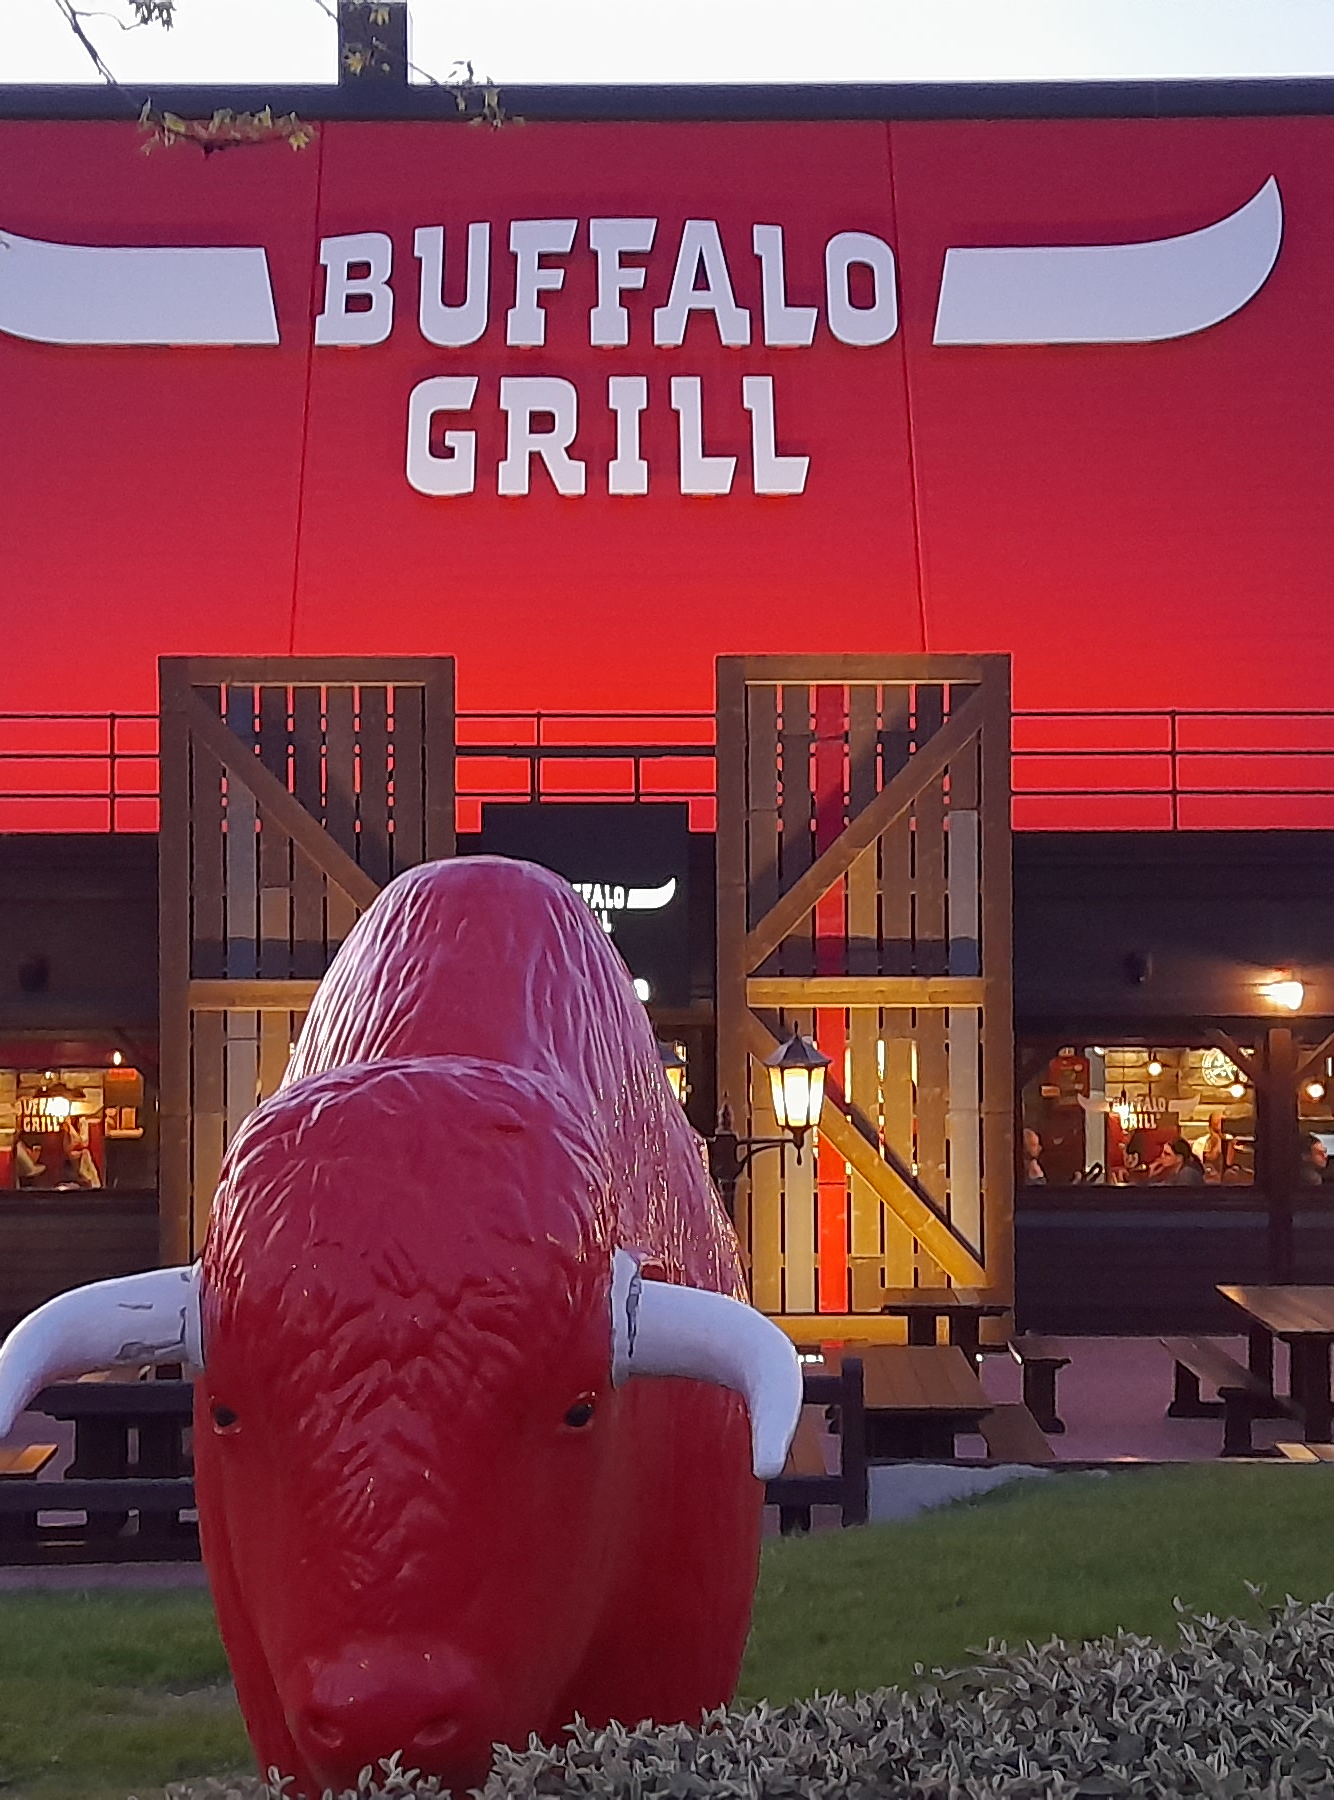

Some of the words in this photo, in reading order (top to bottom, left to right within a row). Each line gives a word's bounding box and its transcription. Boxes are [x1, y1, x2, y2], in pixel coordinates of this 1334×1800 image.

[314, 218, 898, 346] BUFFALO
[406, 376, 810, 496] GRILL
[572, 883, 625, 909] FALO
[23, 1116, 60, 1132] GRILL
